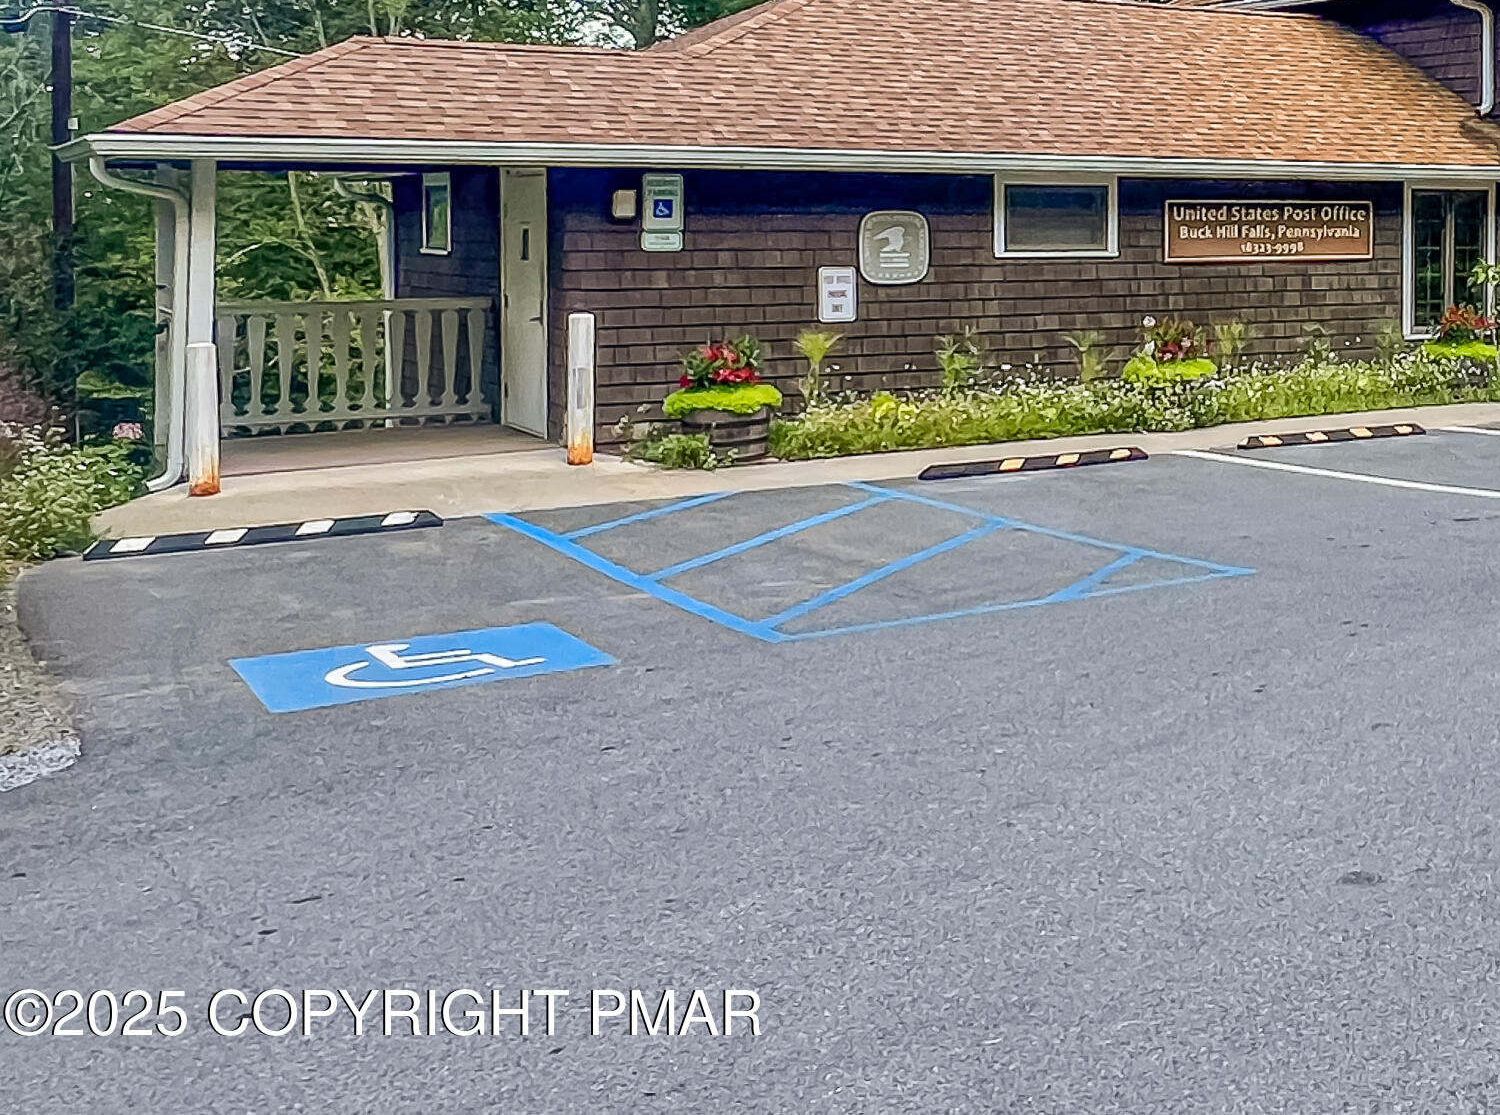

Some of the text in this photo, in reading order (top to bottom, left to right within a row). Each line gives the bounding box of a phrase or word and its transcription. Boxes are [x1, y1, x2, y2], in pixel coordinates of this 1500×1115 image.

[1172, 205, 1367, 222] United States Post Office
[1179, 224, 1361, 242] Buck Hill Falls, Pennsylvania
